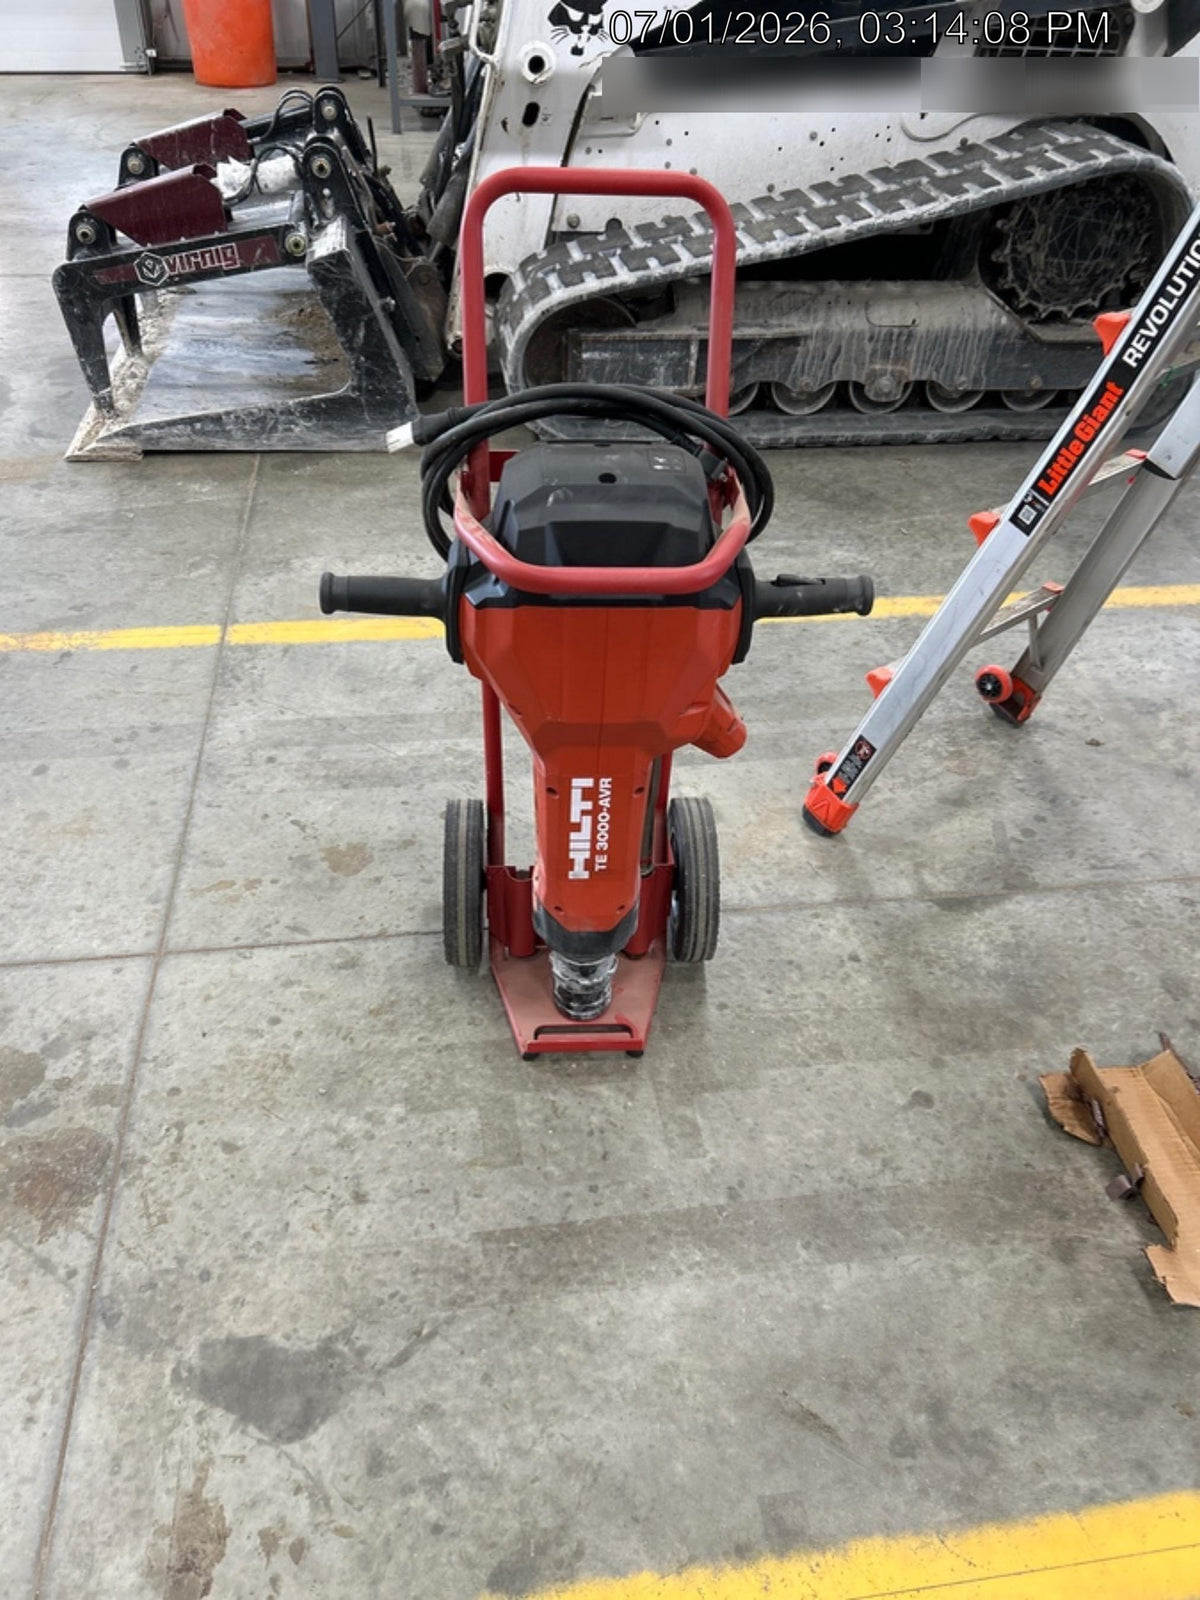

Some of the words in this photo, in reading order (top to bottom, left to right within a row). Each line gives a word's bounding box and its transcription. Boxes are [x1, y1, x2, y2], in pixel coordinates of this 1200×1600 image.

[1122, 232, 1200, 368] REVOLUTIO
[1037, 439, 1085, 495] Little
[1074, 381, 1124, 442] Giant
[568, 778, 594, 879] HILTI
[594, 854, 608, 872] TE
[595, 777, 612, 851] 3000-AVR
